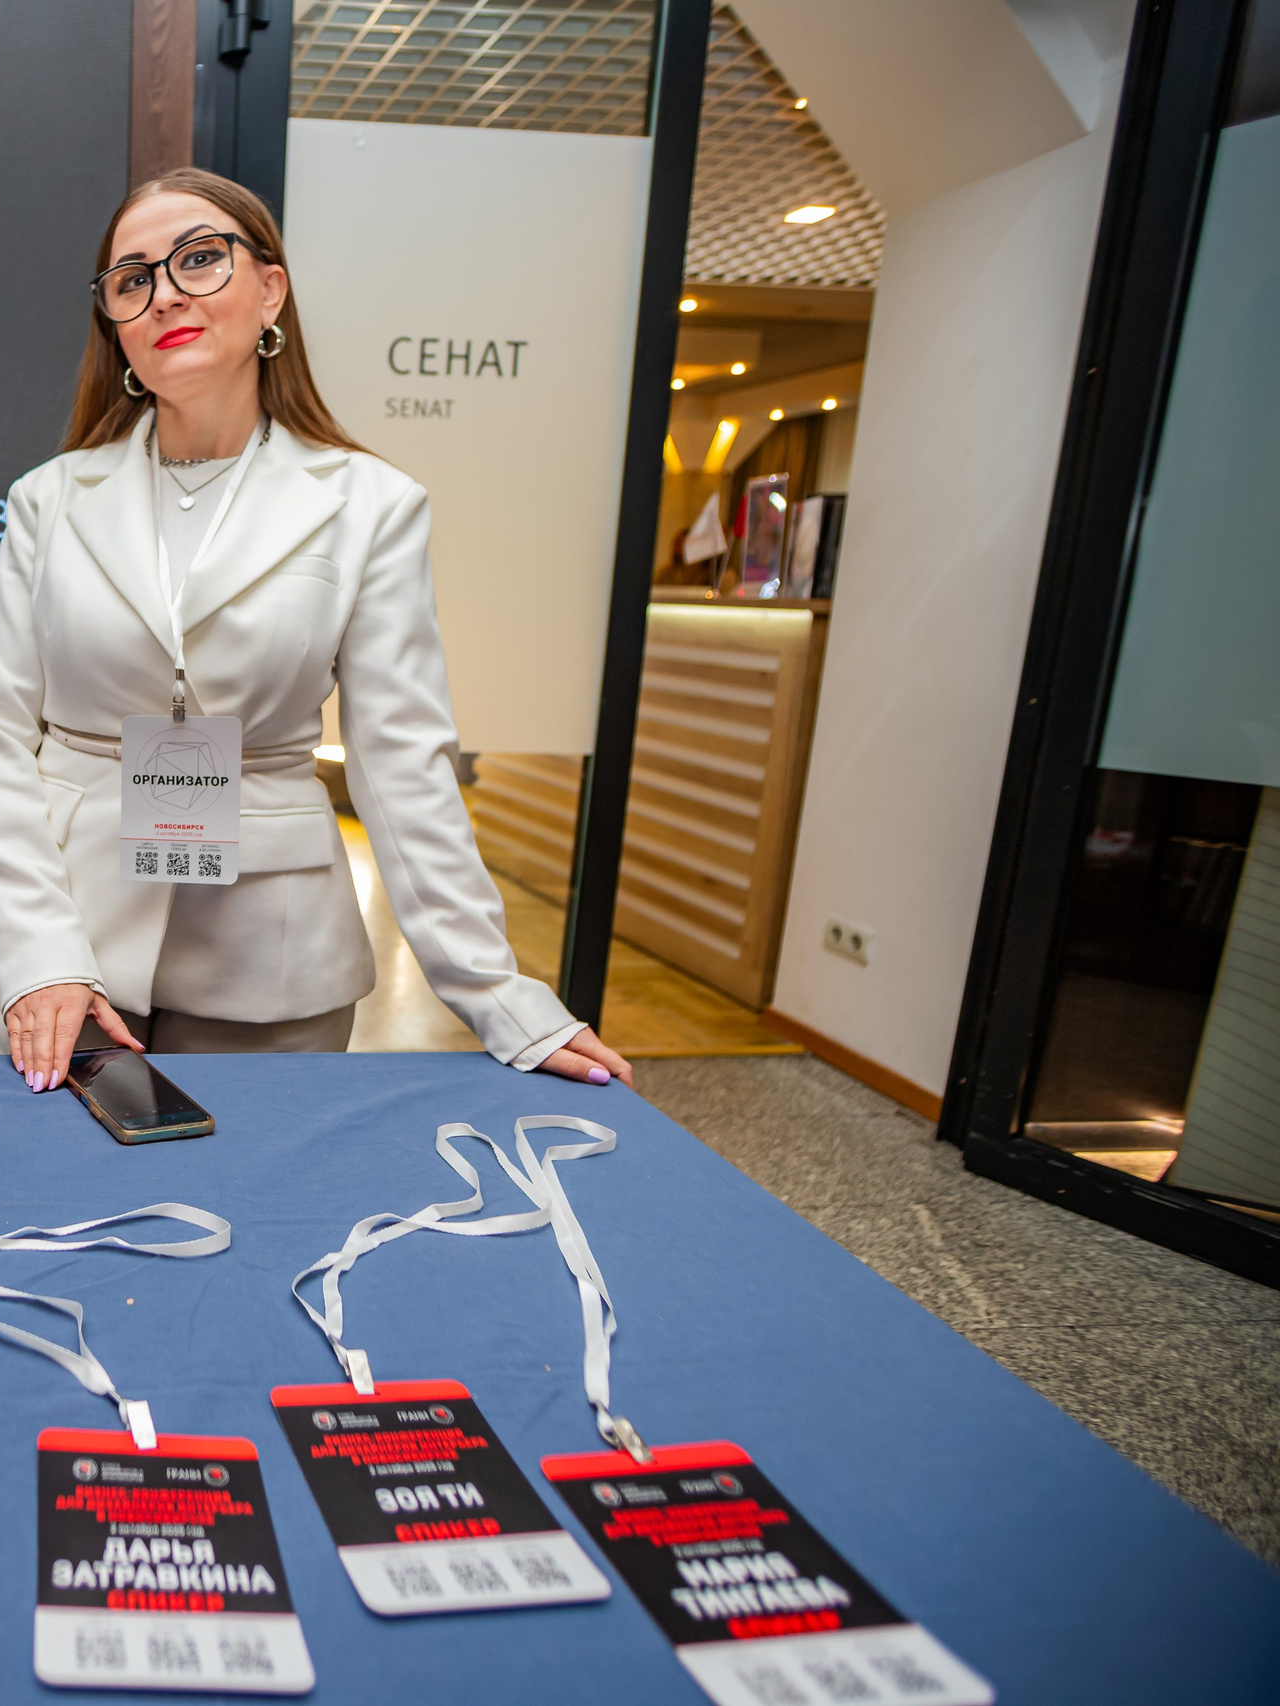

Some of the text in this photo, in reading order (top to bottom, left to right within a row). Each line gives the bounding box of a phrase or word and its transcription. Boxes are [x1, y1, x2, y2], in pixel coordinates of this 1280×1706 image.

[388, 336, 528, 377] СЕНАТ
[385, 397, 454, 418] SENAT
[132, 774, 229, 787] ОРГАНИЗАТОР
[154, 823, 205, 831] НОВОСИБИРСК
[396, 1410, 430, 1422] ГРАНИ
[375, 1483, 484, 1513] ЗОЯ ТИ
[103, 1537, 217, 1567] ДАРЬЯ
[52, 1559, 275, 1593] ЗАТРАВКИНА
[678, 1553, 797, 1588] МАРИЯ
